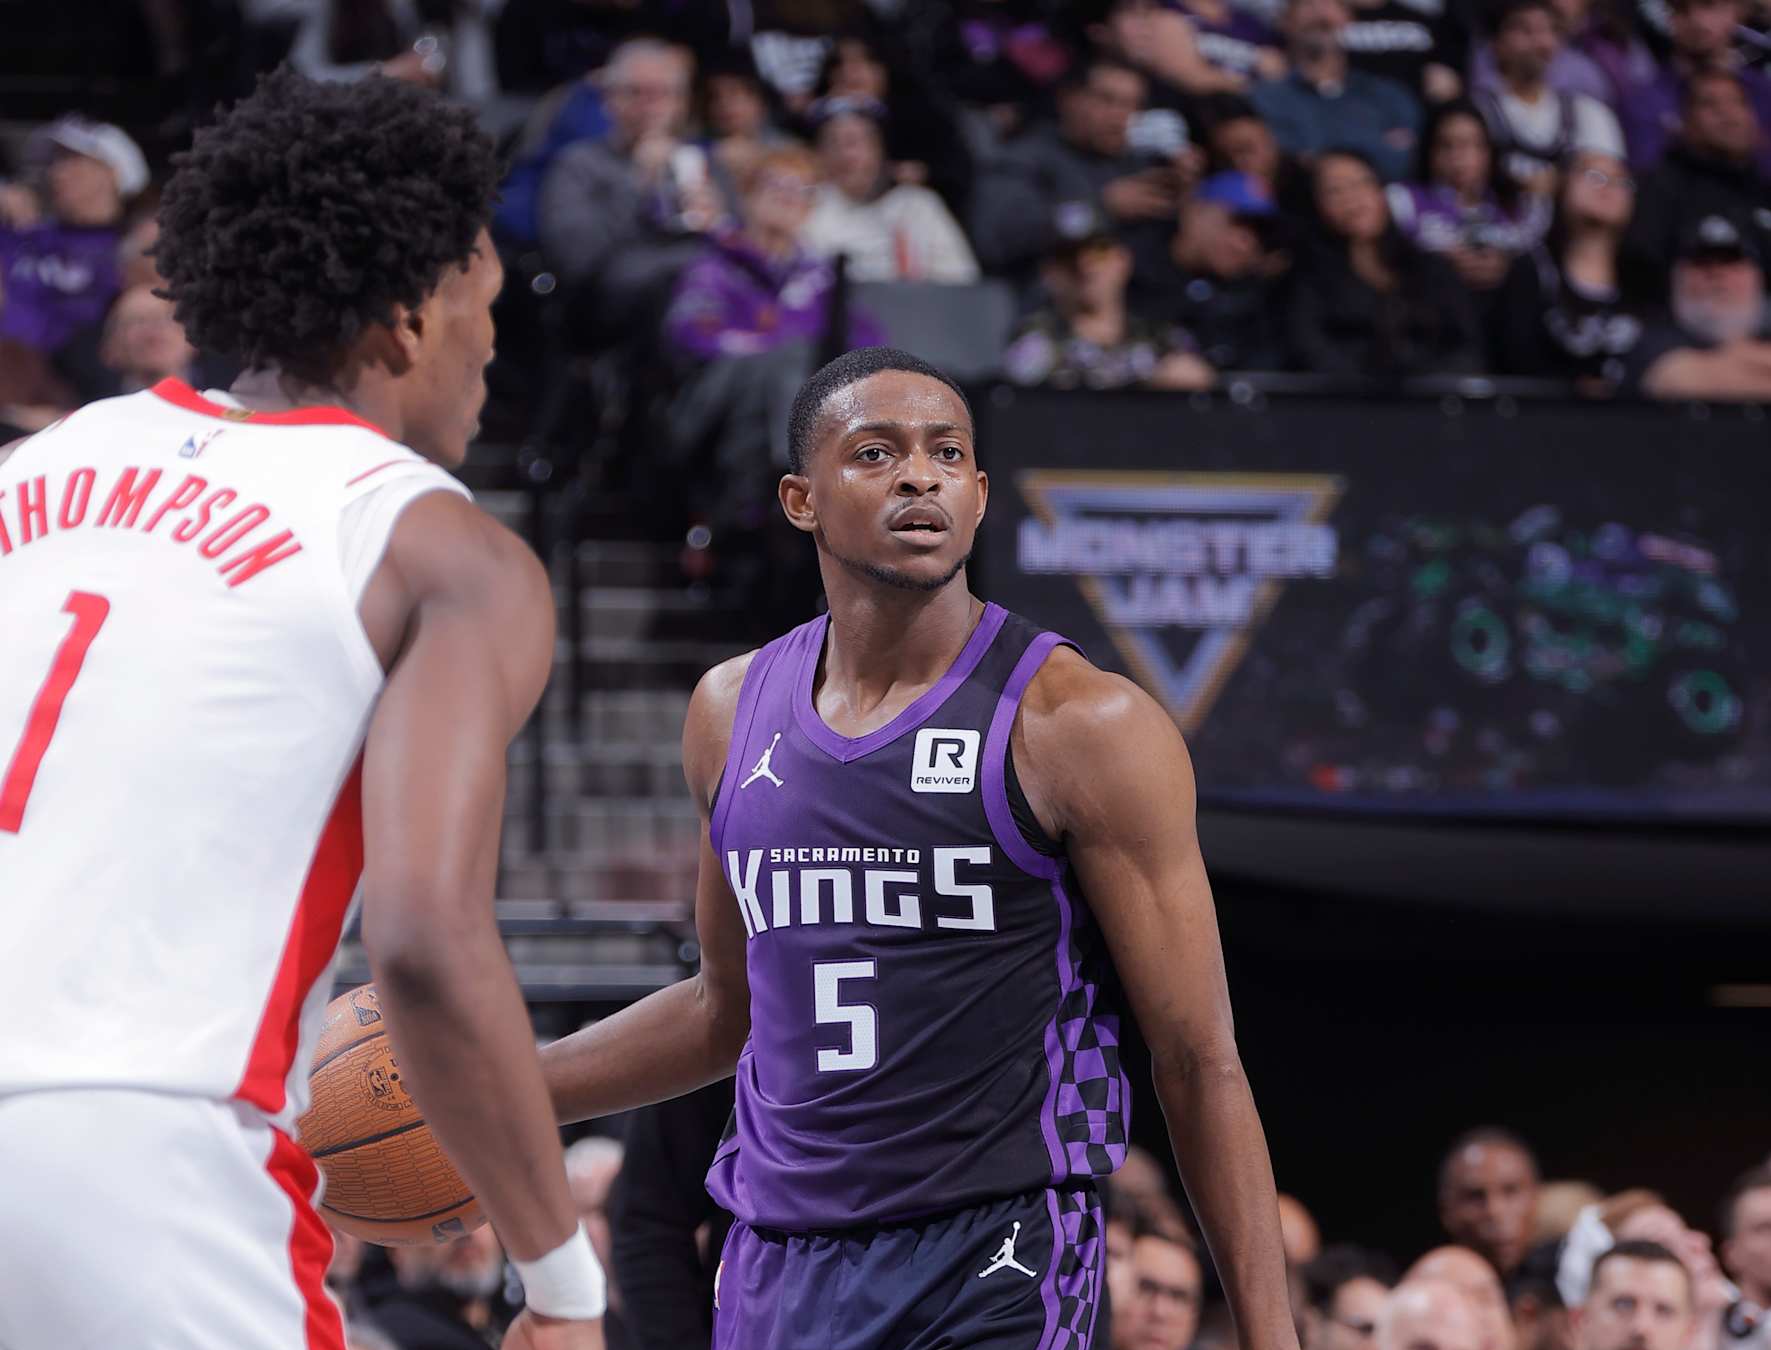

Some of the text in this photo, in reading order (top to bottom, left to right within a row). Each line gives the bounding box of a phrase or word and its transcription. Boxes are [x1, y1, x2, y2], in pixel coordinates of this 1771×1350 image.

[0, 590, 110, 835] 1
[916, 776, 970, 785] REVIVER
[928, 737, 966, 769] R
[770, 848, 920, 864] SACRAMENTO
[727, 846, 996, 940] KINGS
[813, 960, 876, 1072] 5
